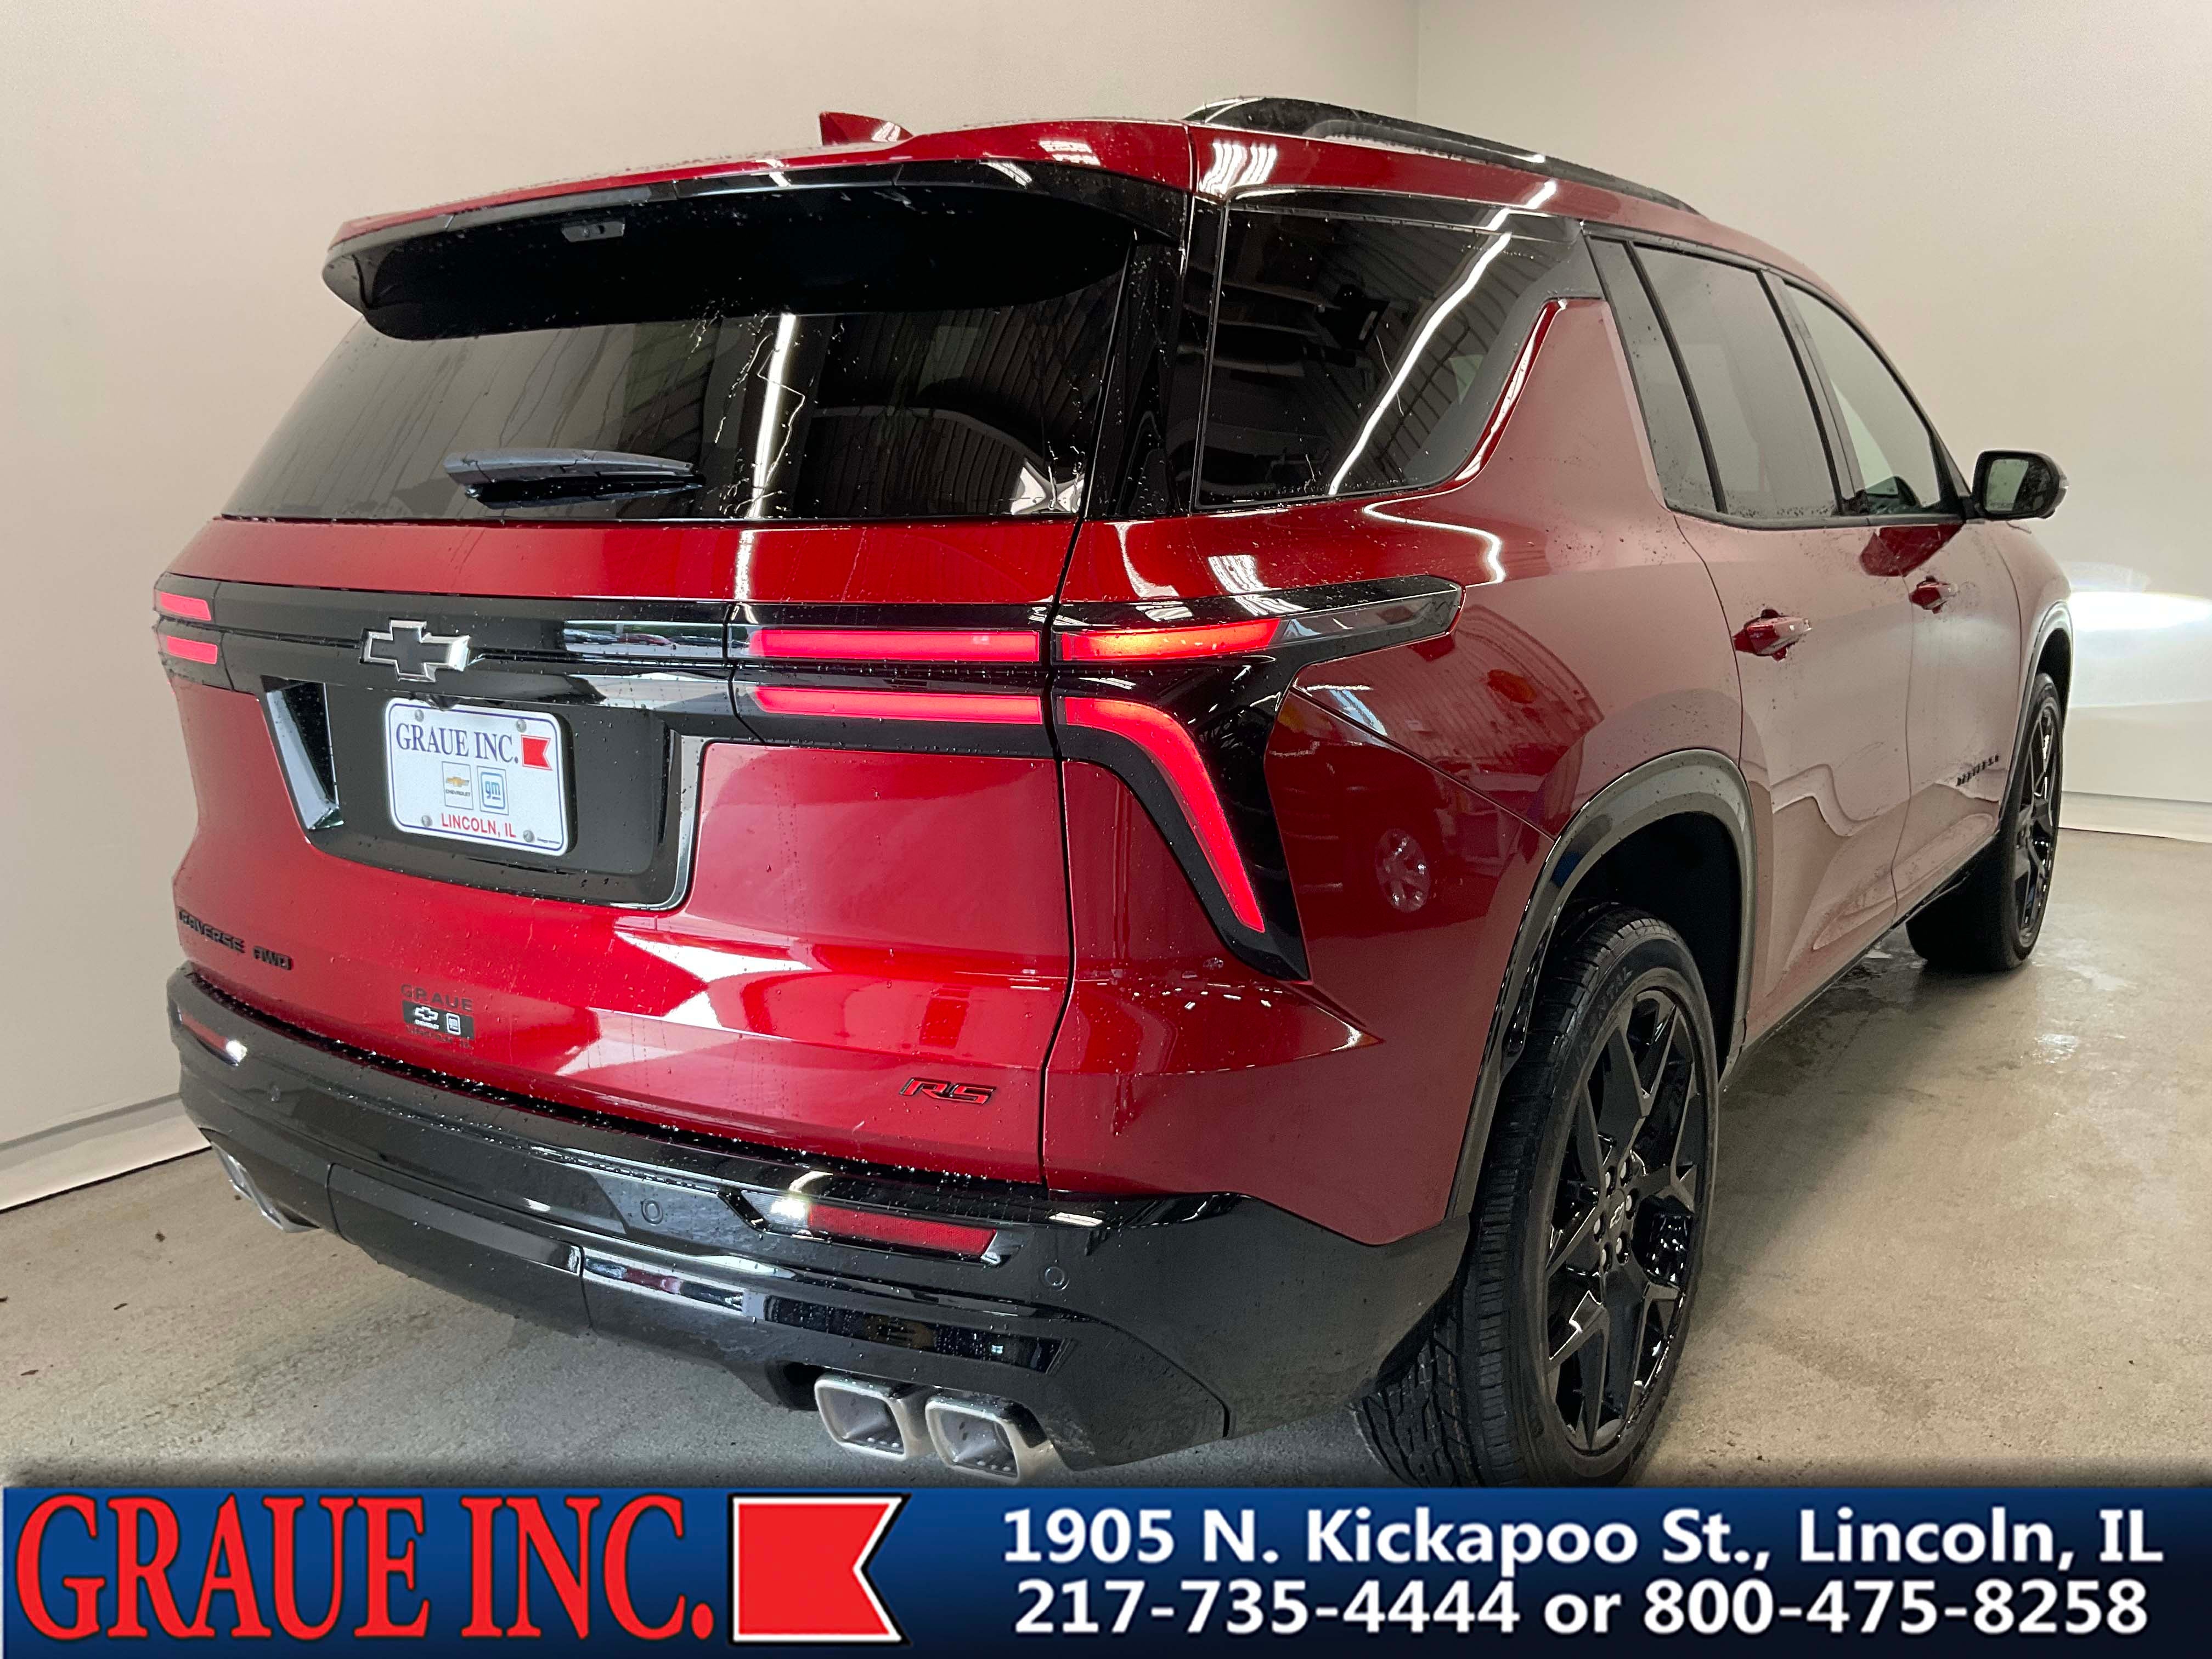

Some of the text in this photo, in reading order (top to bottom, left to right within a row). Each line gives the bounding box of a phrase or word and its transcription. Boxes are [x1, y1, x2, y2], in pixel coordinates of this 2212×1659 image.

[396, 723, 519, 764] GRAUE INC.
[445, 789, 471, 797] CHEVROLET
[484, 781, 501, 799] gm
[441, 813, 517, 838] LINCOLN, IL
[253, 945, 293, 970] AWD
[401, 984, 473, 1011] GRAUE
[899, 1076, 996, 1105] RS
